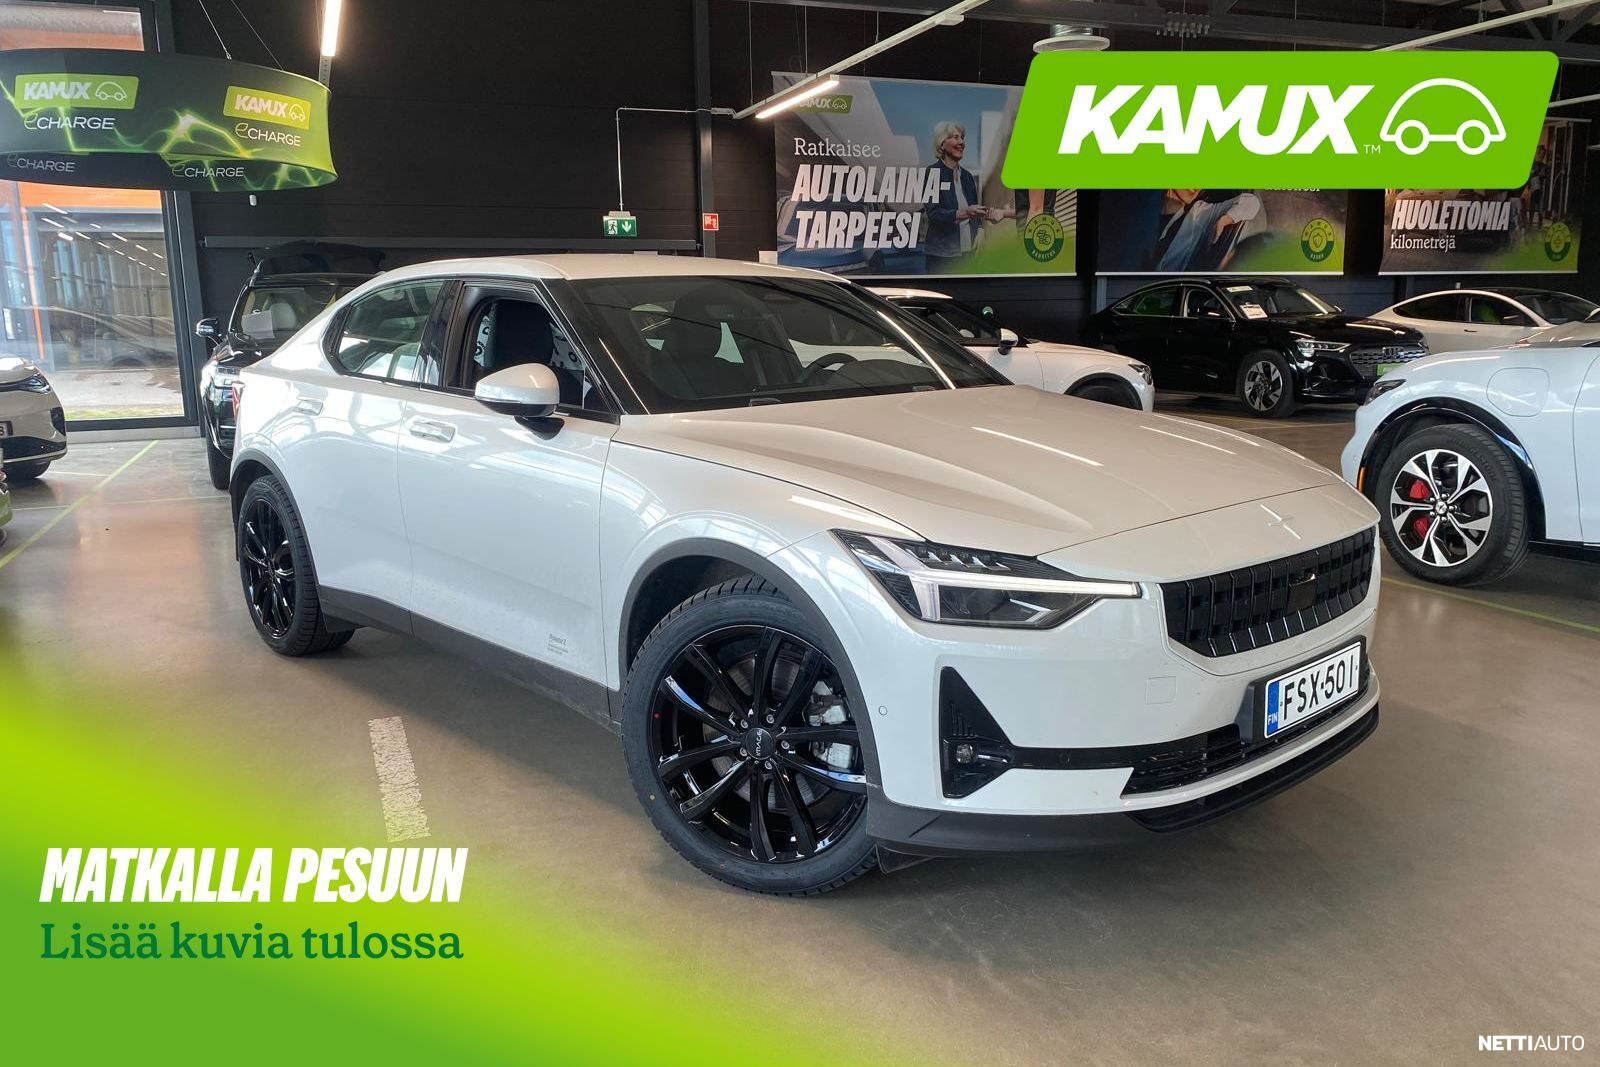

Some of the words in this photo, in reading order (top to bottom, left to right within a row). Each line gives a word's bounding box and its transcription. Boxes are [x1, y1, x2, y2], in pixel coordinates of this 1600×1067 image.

[24, 81, 92, 101] KAMUX
[796, 96, 831, 108] AMUX
[235, 93, 289, 118] KAMUX
[794, 137, 881, 157] Ratkaisee
[791, 164, 951, 204] AUTOLAINA-
[1391, 199, 1511, 231] HUOLETTOMIA
[795, 211, 921, 249] TARPEESI
[1390, 234, 1456, 252] kilometrejä
[1283, 655, 1354, 720] FSX-501
[1267, 711, 1279, 726] FIN
